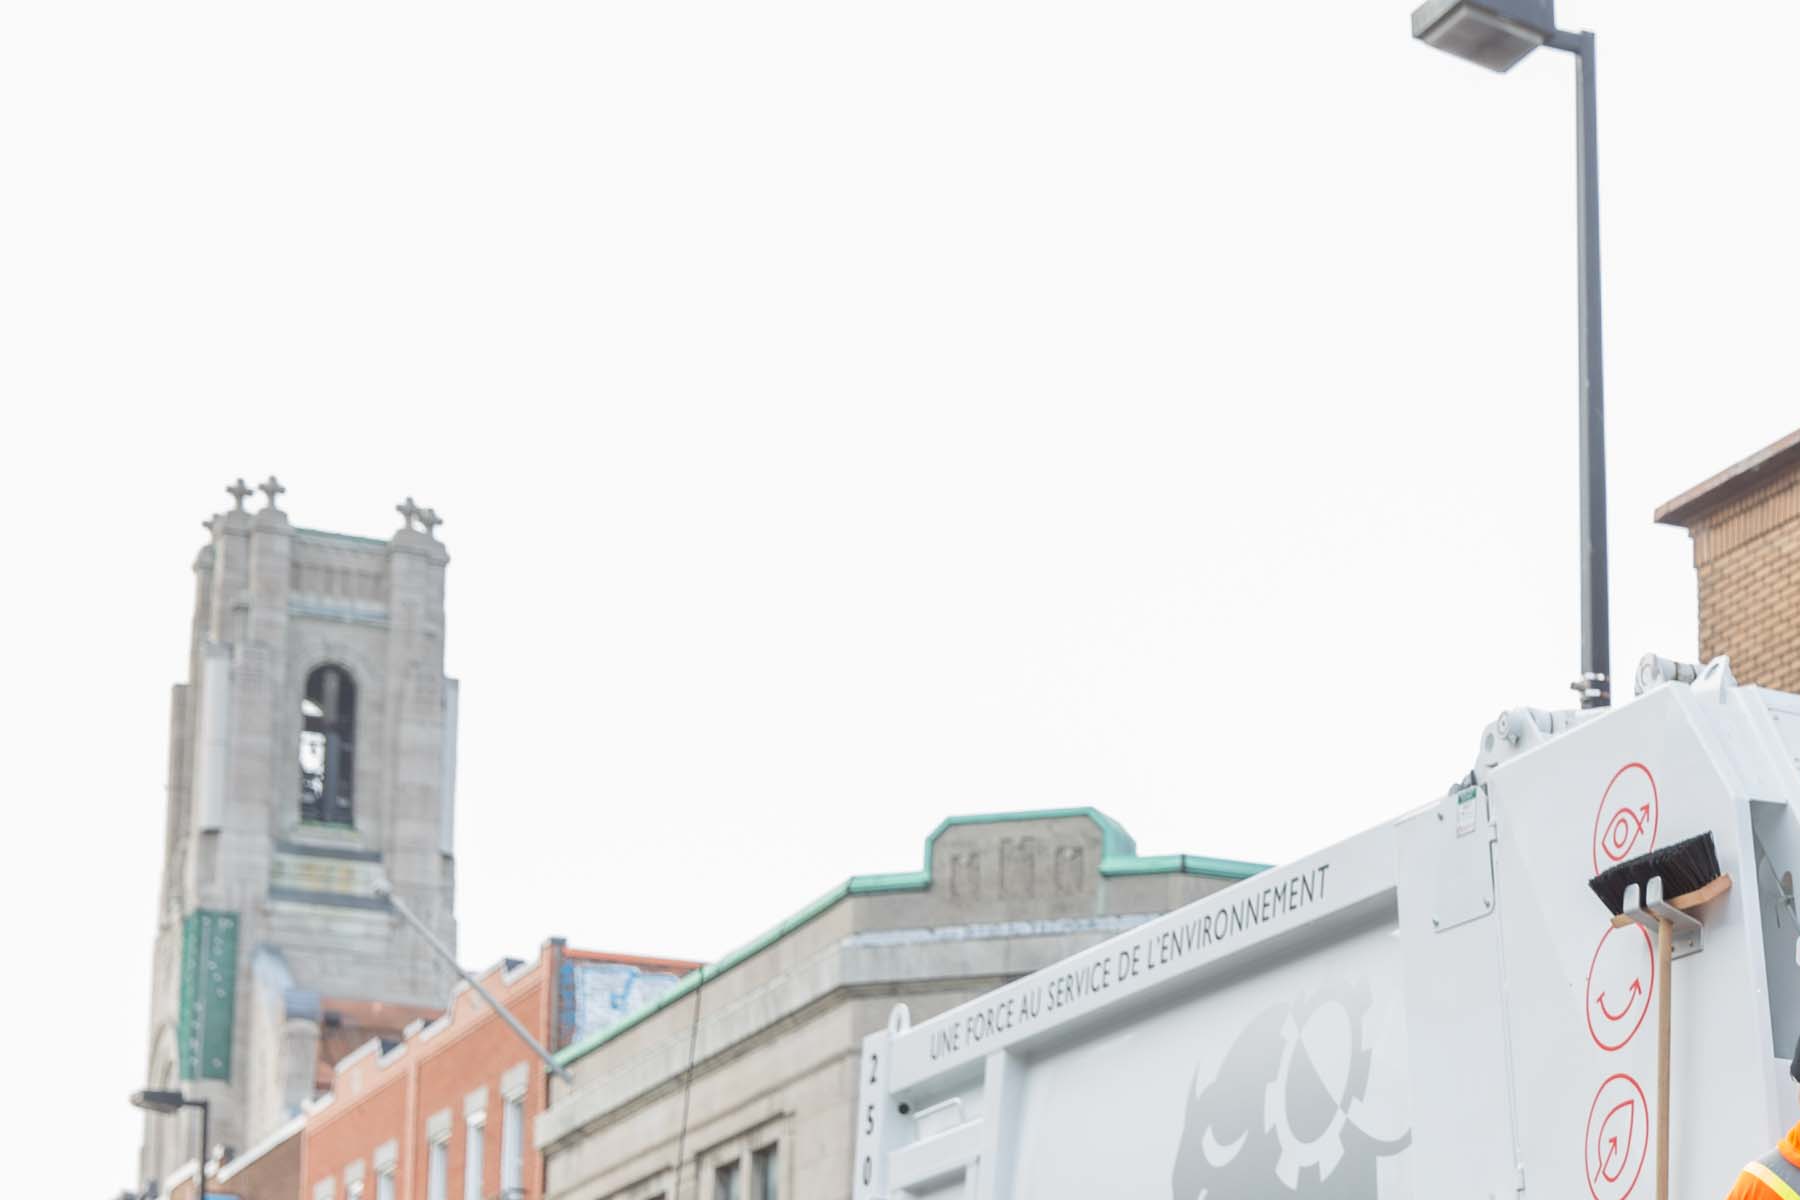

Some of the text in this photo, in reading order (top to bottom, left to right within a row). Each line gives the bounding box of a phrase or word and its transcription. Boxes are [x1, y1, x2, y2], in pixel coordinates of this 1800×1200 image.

[930, 863, 1330, 1061] UNE FORCE AU SERVICE DE L'ENVIRONNEMENT
